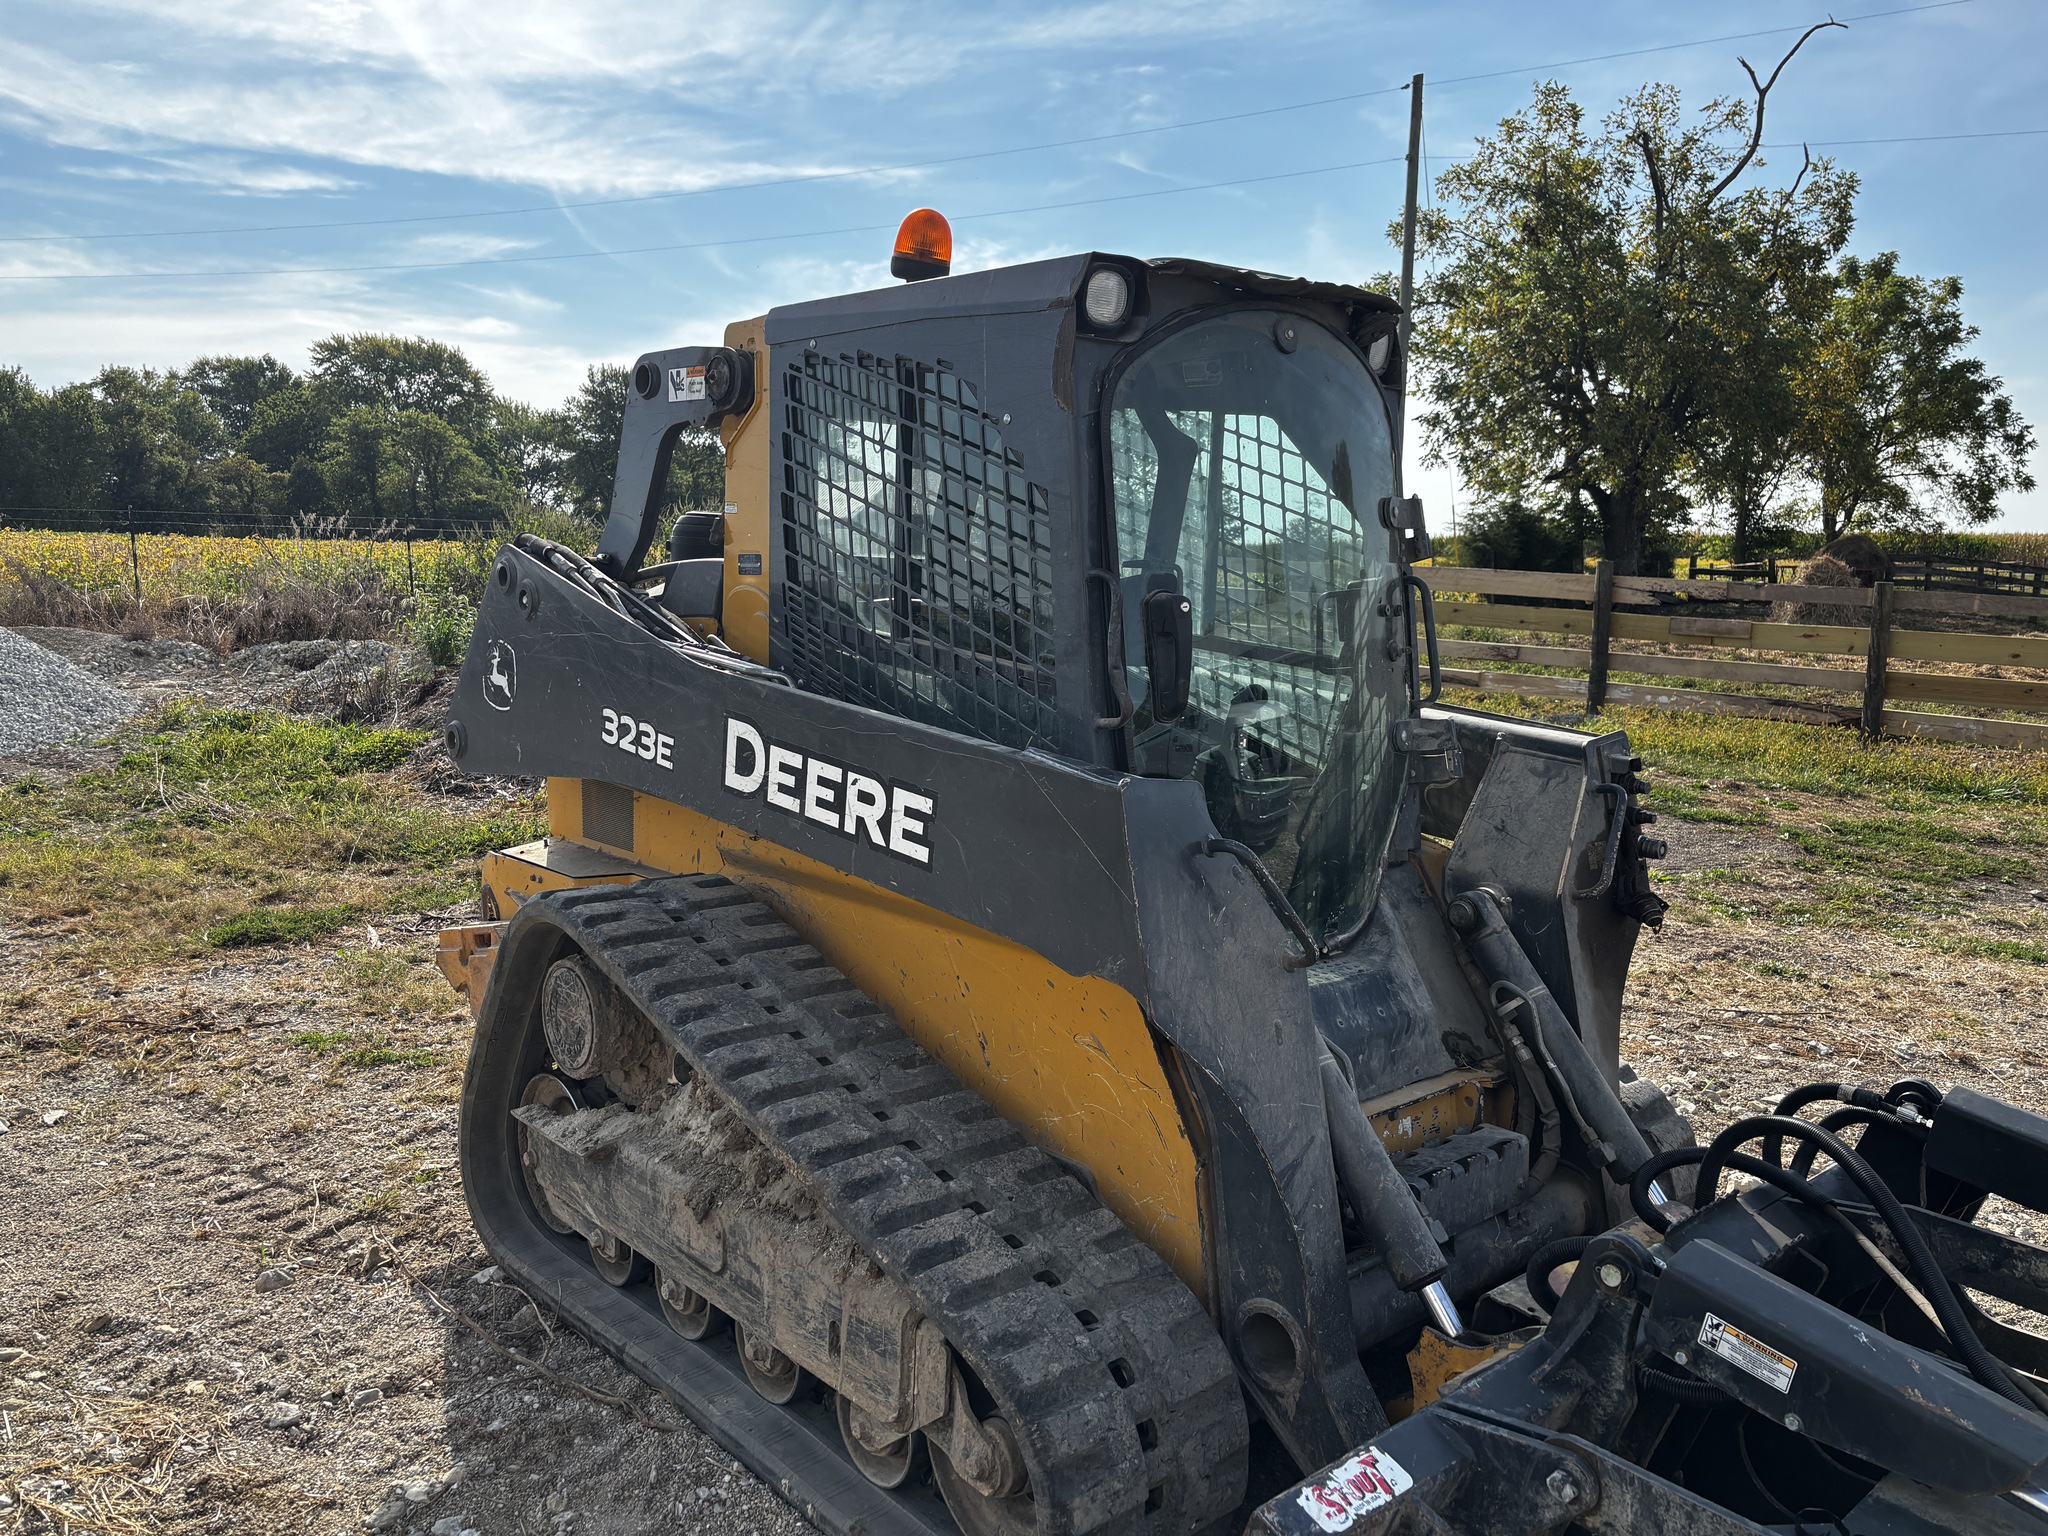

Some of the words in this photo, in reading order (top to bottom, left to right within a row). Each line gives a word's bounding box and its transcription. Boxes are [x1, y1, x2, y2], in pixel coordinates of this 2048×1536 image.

[601, 708, 675, 770] 323E
[724, 717, 933, 864] DEERE
[1739, 1334, 1784, 1363] WARNING
[1312, 1454, 1393, 1520] STOUT
